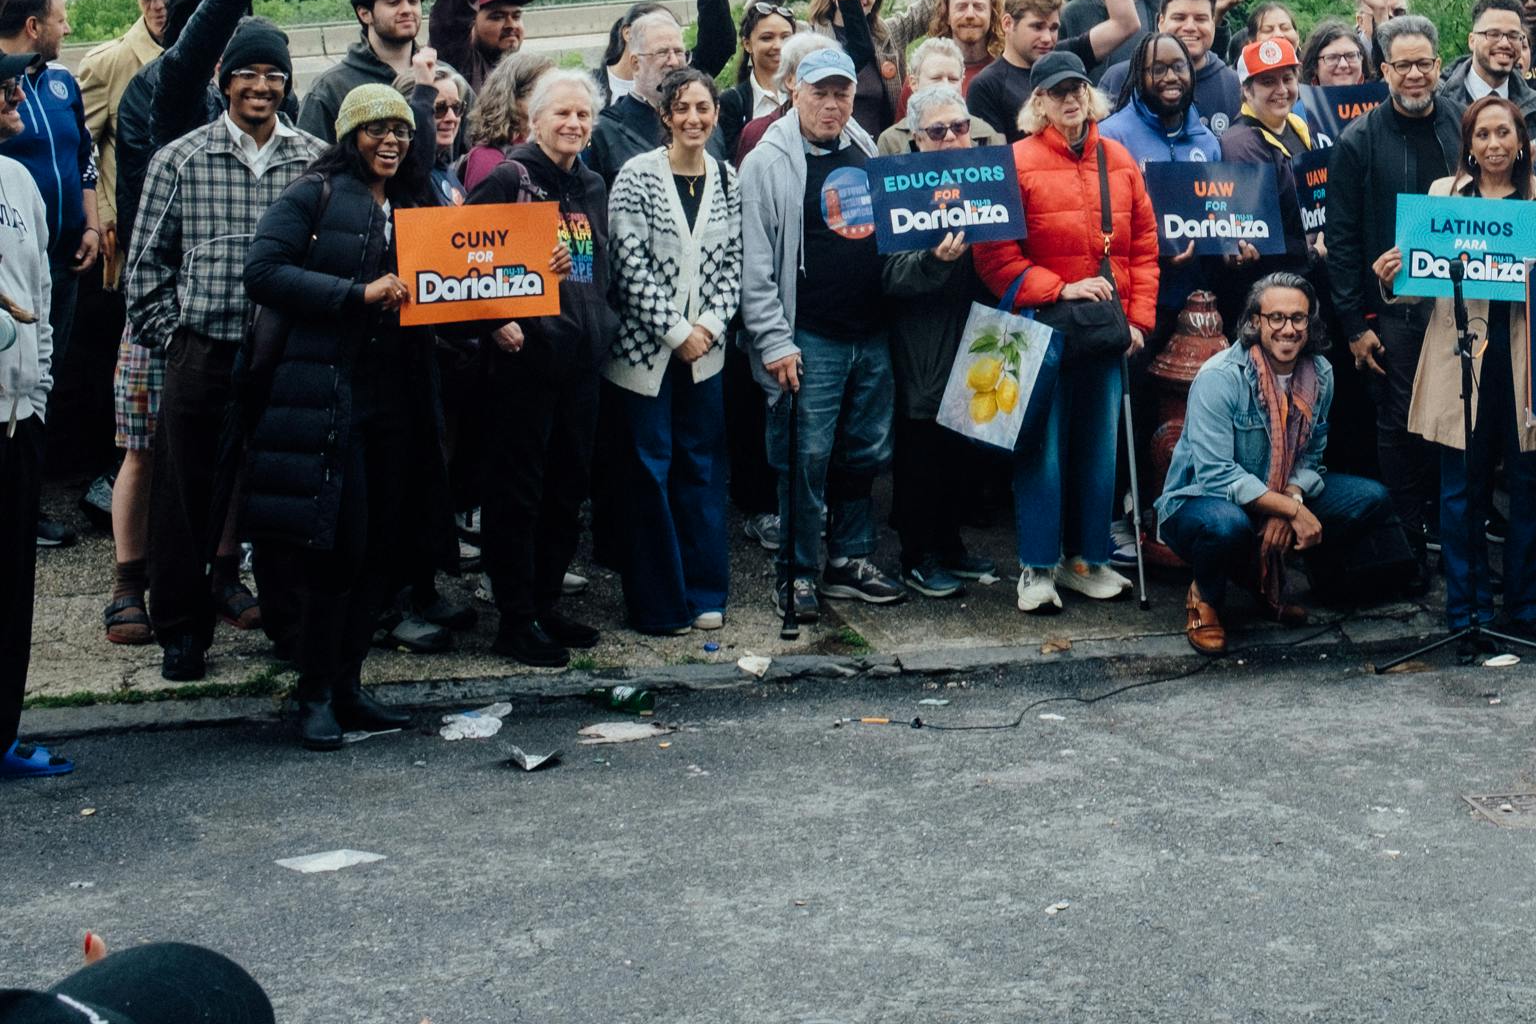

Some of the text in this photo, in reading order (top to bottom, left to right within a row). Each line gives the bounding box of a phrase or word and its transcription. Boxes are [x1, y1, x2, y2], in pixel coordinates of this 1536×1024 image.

[884, 165, 1005, 192] EDUCATORS
[1306, 168, 1328, 187] UAW
[934, 189, 960, 201] FOR
[1194, 181, 1235, 197] UAW
[1313, 188, 1326, 201] FOR
[1205, 201, 1227, 211] FOR
[890, 199, 1009, 234] Darializa
[1164, 213, 1270, 239] Darializa
[1431, 218, 1513, 237] LATINOS
[451, 229, 509, 249] CUNY
[1454, 239, 1487, 250] PARA
[467, 251, 494, 264] FOR
[1412, 251, 1525, 282] Daializa
[418, 268, 543, 303] Darializa
